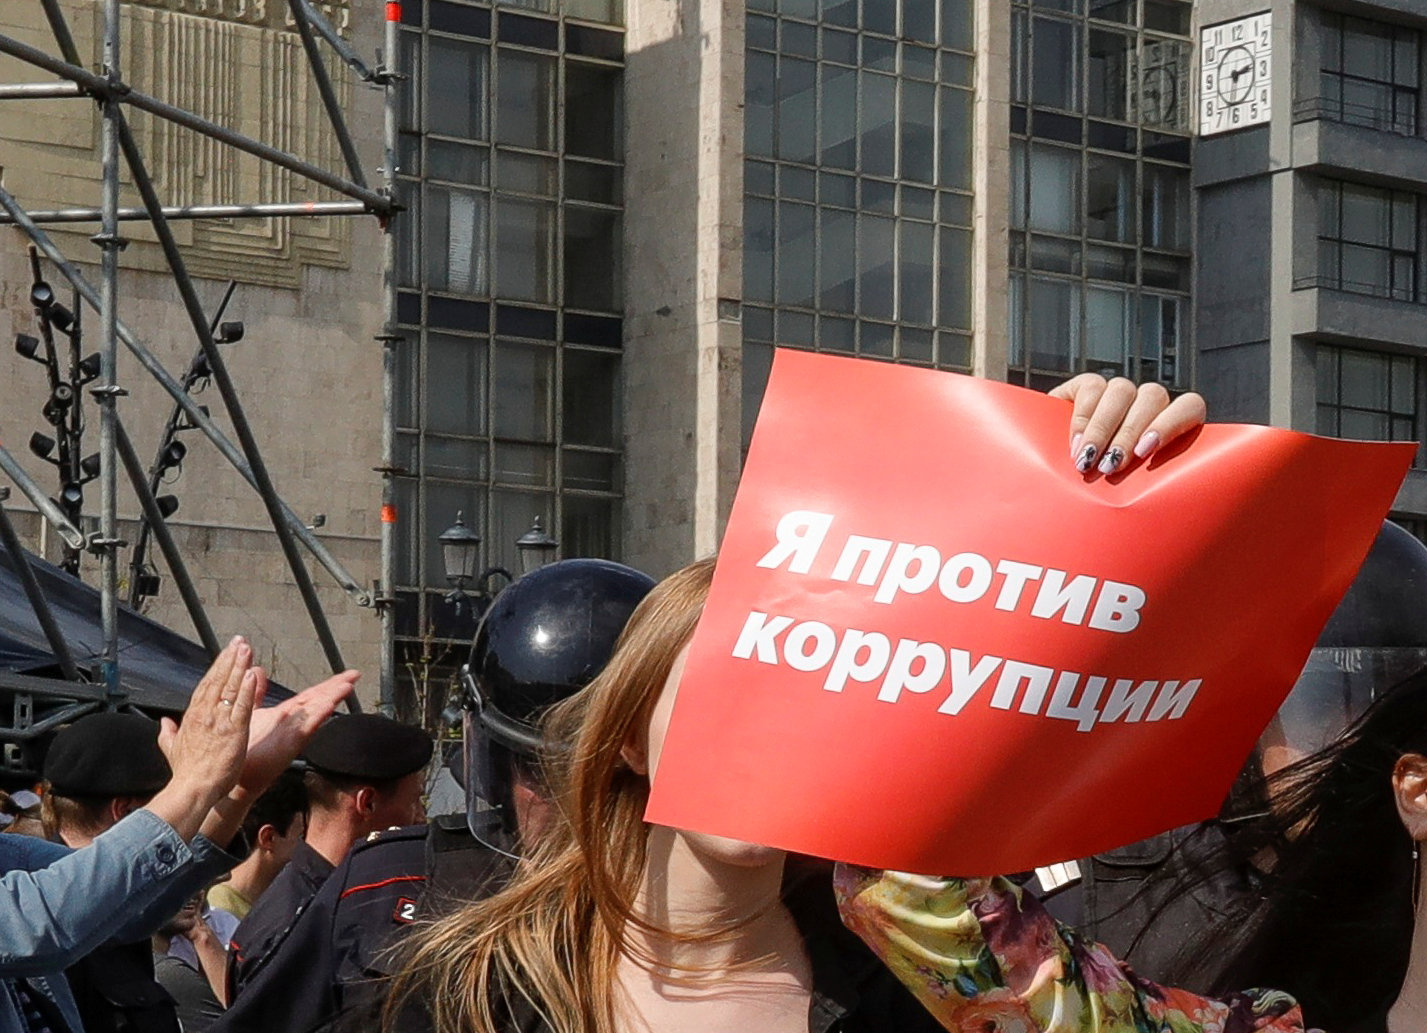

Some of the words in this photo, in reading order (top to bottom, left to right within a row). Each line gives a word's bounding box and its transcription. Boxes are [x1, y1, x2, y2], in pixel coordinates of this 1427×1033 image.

[1231, 24, 1243, 42] 12
[1260, 30, 1269, 47] 2
[1259, 60, 1268, 77] 3
[1205, 74, 1213, 90] 9
[1261, 89, 1267, 104] 4
[1205, 101, 1214, 117] 8
[1232, 107, 1240, 123] 6
[1250, 103, 1258, 119] 5
[1215, 111, 1223, 129] 7
[756, 510, 834, 574] Я
[830, 534, 1146, 634] против
[731, 610, 1203, 733] коррупции
